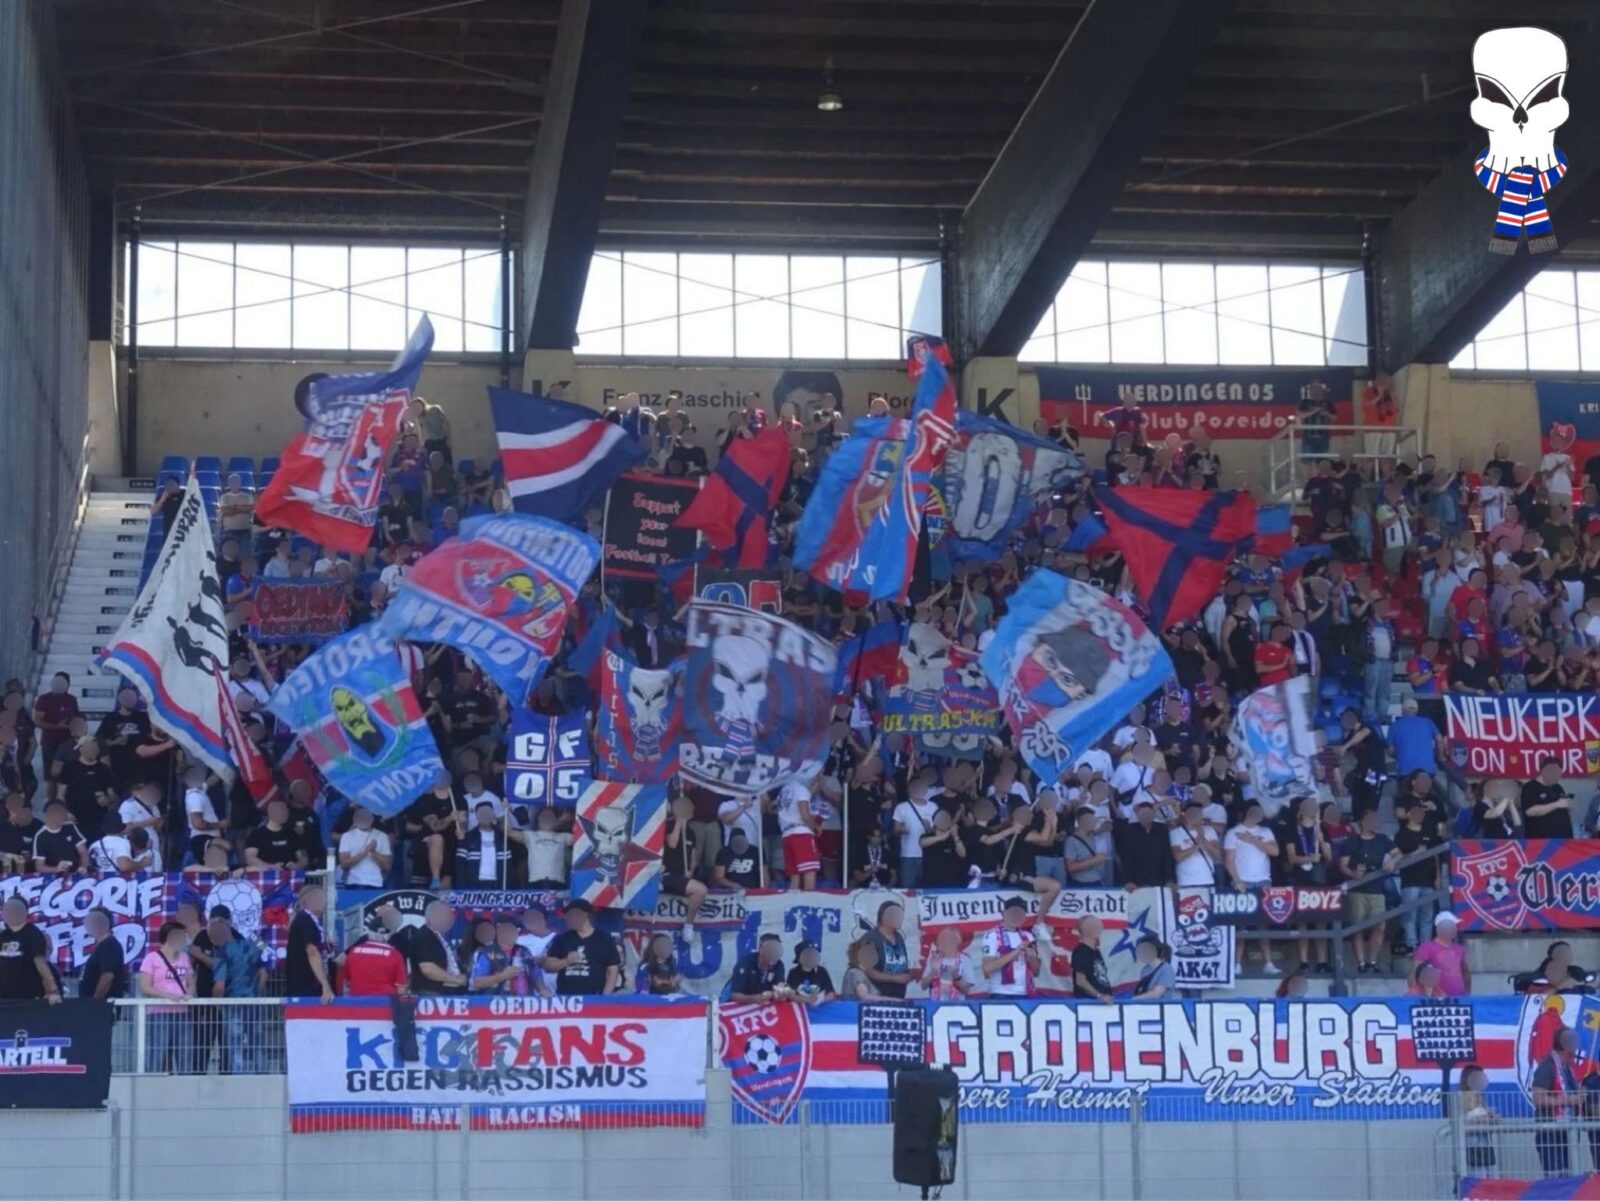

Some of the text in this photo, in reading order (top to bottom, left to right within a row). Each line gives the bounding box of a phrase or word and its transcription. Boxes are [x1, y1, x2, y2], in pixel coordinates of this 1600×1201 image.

[1249, 383, 1274, 401] 05
[977, 388, 1016, 426] K
[1194, 411, 1286, 430] Poseido
[1443, 694, 1600, 743] NIEUKERK
[1471, 747, 1505, 775] ON
[1060, 892, 1127, 914] Stadt
[1297, 890, 1342, 911] BOYZ
[1176, 961, 1221, 979] AK47
[416, 995, 584, 1016] OVE OEDING
[731, 1005, 779, 1036] KFC
[476, 1022, 648, 1068] FANS
[932, 1002, 1399, 1083] GROTENBURG
[346, 1066, 648, 1092] GEGEN RASSISMUS
[1199, 1066, 1296, 1107] Unser
[1312, 1070, 1442, 1109] Stadion
[411, 1104, 581, 1125] HAT RACISM
